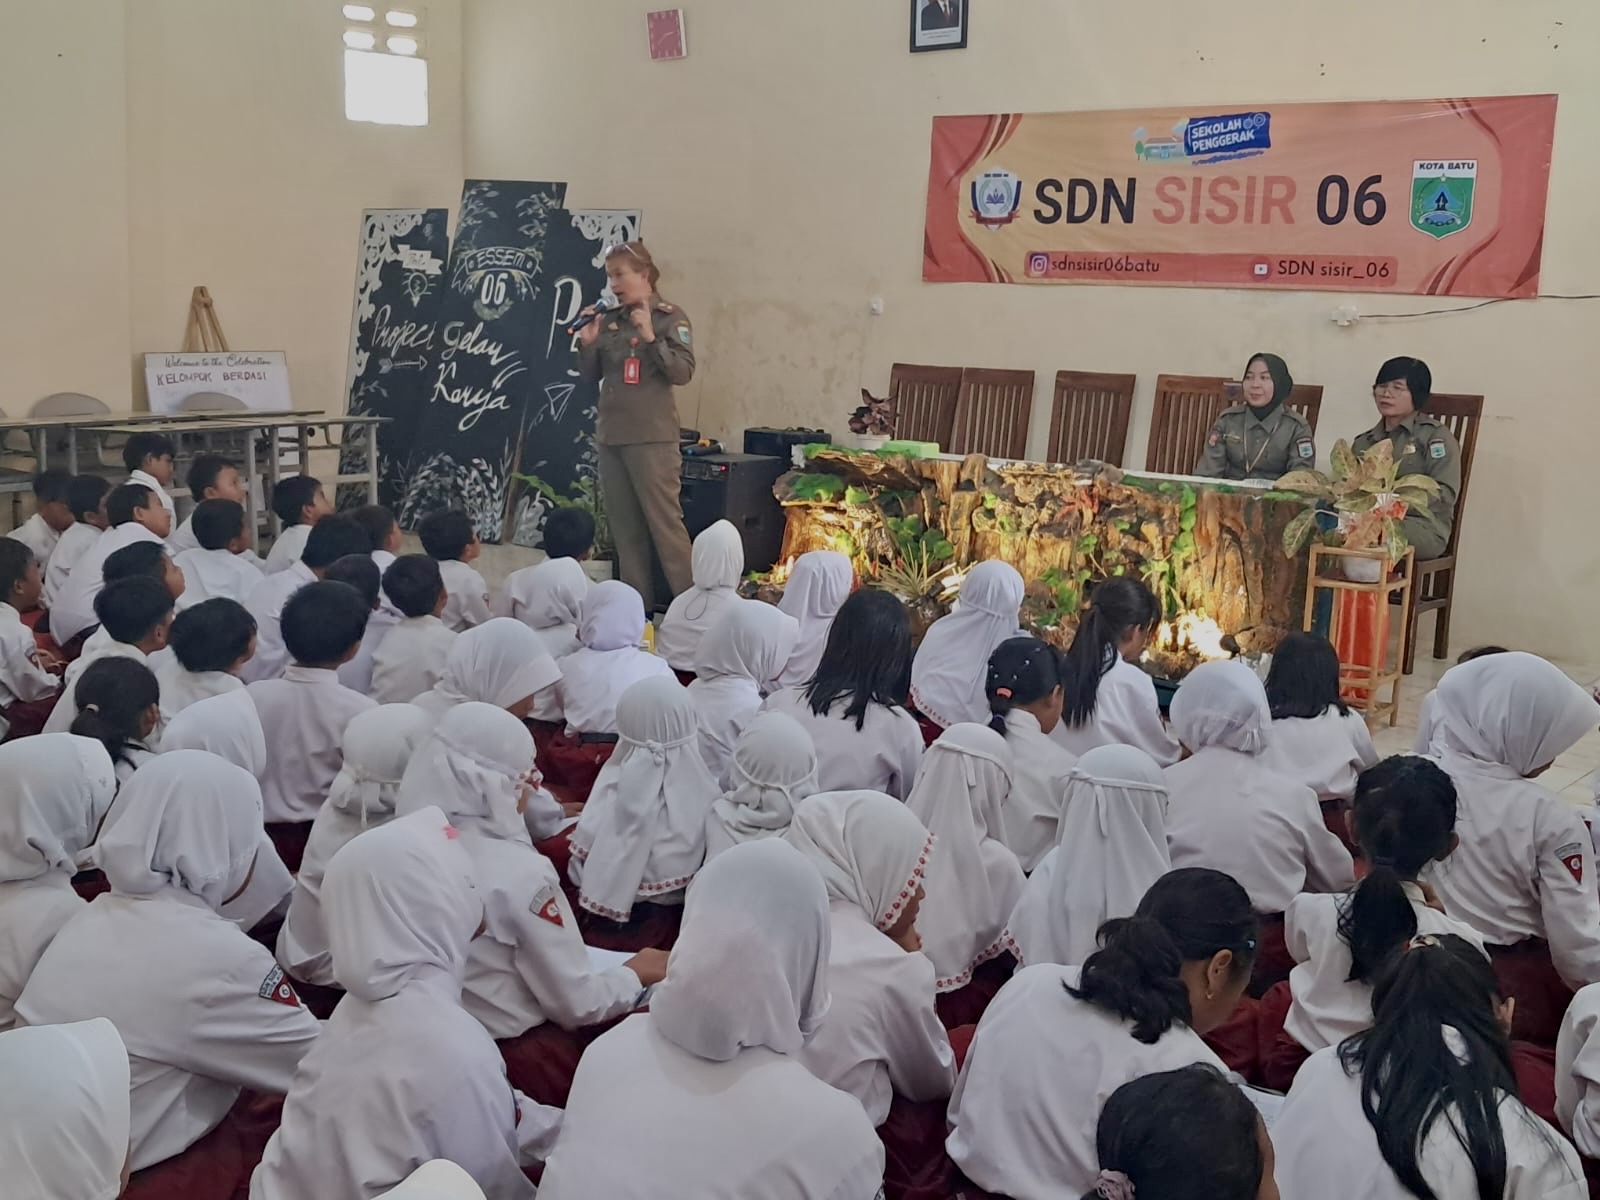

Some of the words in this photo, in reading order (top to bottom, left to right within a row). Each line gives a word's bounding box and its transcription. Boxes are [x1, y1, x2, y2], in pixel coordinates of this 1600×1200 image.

[1191, 118, 1242, 139] SEKOLAH
[1192, 129, 1255, 153] PENGGERAK
[1418, 162, 1445, 170] KOTA
[1447, 162, 1475, 170] BATU
[1033, 177, 1137, 225] SDN
[1152, 175, 1297, 225] SISIR
[1316, 174, 1387, 226] 06
[1051, 252, 1160, 273] sdnsisir06batu
[1278, 260, 1315, 276] SDN
[481, 272, 509, 305] 06
[165, 355, 199, 368] Welcome
[201, 358, 209, 366] to
[211, 357, 222, 366] the
[157, 371, 212, 386] KELOMPOK
[223, 371, 267, 381] BERDASI
